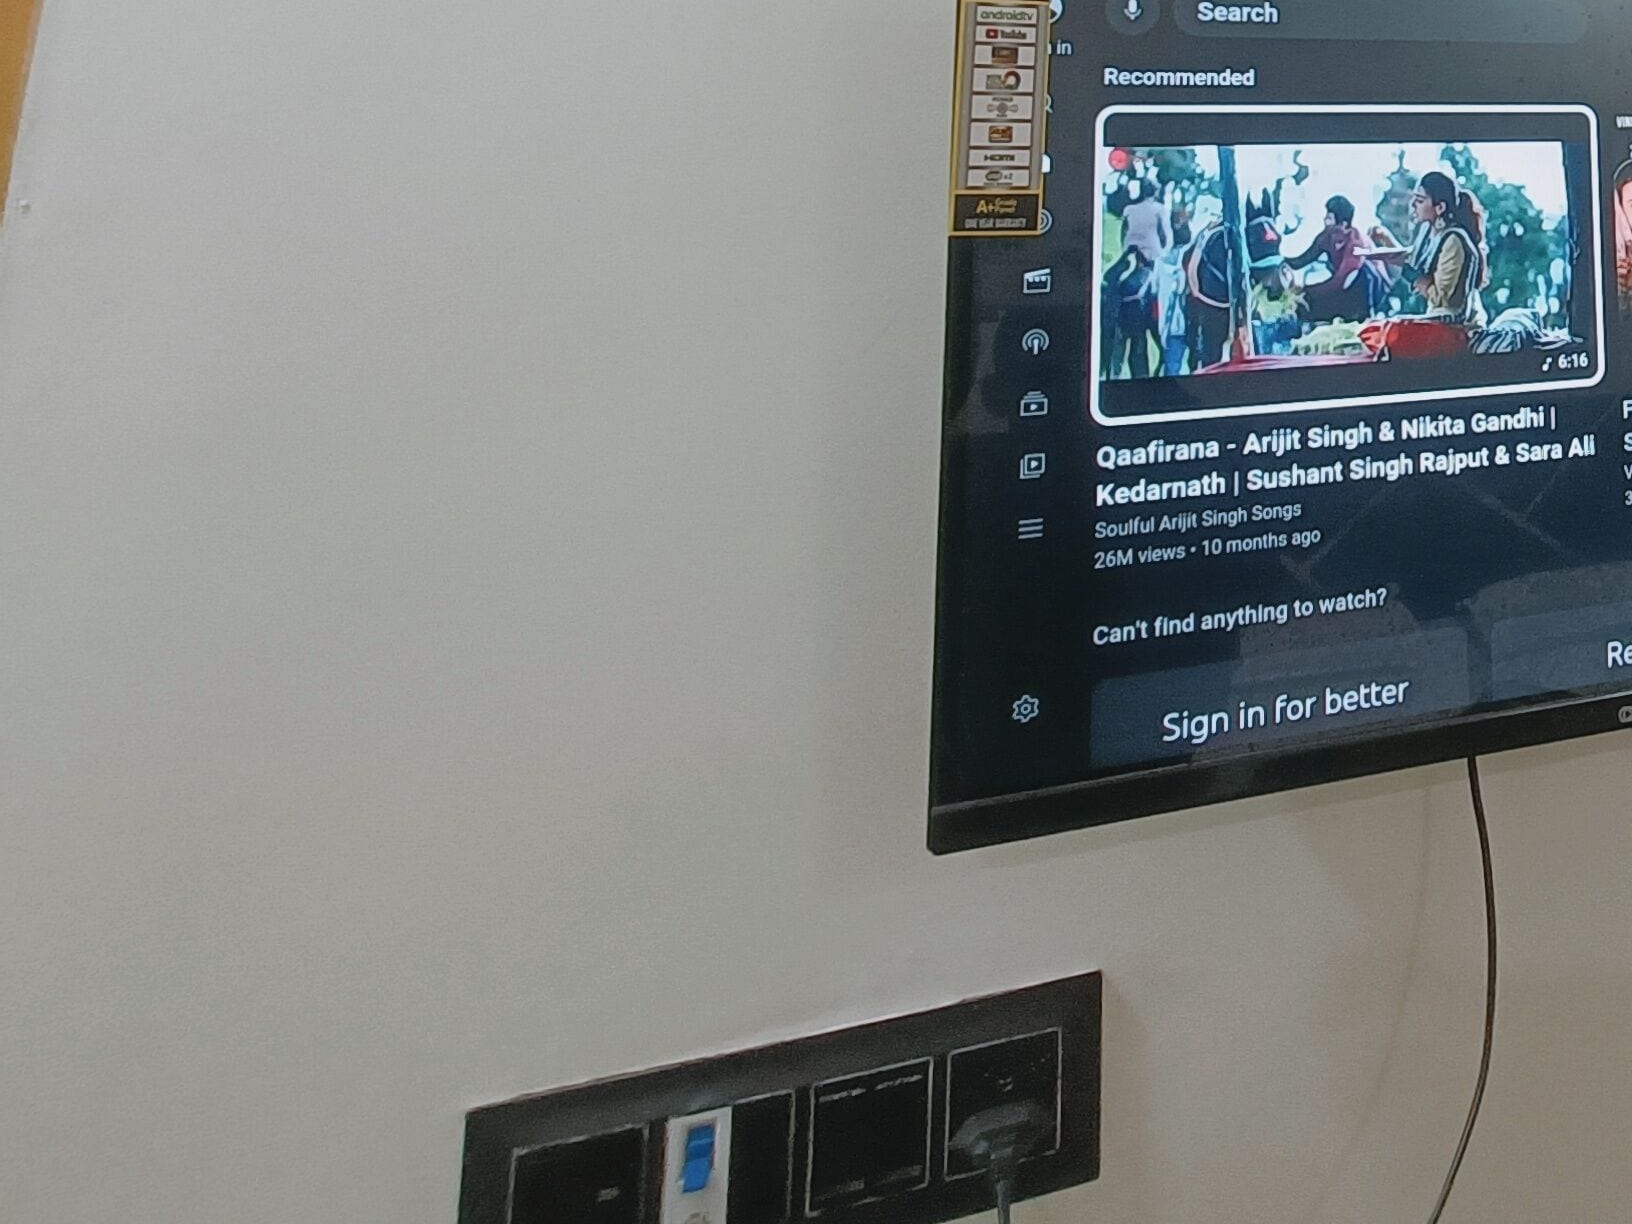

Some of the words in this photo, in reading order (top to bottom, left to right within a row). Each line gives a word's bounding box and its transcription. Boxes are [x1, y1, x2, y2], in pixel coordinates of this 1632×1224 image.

[1197, 0, 1279, 24] Search
[1103, 67, 1256, 87] Recommended
[1558, 352, 1589, 369] 6:16
[1096, 439, 1220, 471] Qaafirana
[1242, 428, 1302, 457] Arijit
[1307, 422, 1373, 450] Singh
[1378, 420, 1395, 442] &
[1400, 414, 1466, 441] Nikita
[1470, 406, 1545, 433] Gandhi
[1096, 471, 1226, 507] Kedarnath
[1246, 460, 1344, 491] Sushant
[1349, 453, 1413, 481] Singh
[1419, 447, 1490, 476] Rajput
[1494, 444, 1510, 465] &
[1515, 440, 1563, 463] Sara
[1567, 434, 1596, 458] Ali
[1094, 516, 1155, 539] Soulful
[1158, 512, 1198, 534] Arijit
[1201, 507, 1248, 527] Singh
[1251, 502, 1302, 522] Songs
[1094, 550, 1133, 570] 26M
[1137, 545, 1186, 565] views
[1202, 538, 1223, 557] 10
[1226, 531, 1288, 554] months
[1291, 529, 1322, 549] ago
[1092, 620, 1149, 646] Can't
[1154, 613, 1195, 637] find
[1200, 603, 1288, 632] anything
[1293, 599, 1314, 617] to
[1318, 587, 1387, 615] watch?
[1162, 711, 1229, 745] Sign
[1238, 700, 1265, 730] in
[1274, 693, 1317, 724] for
[1324, 680, 1410, 716] better
